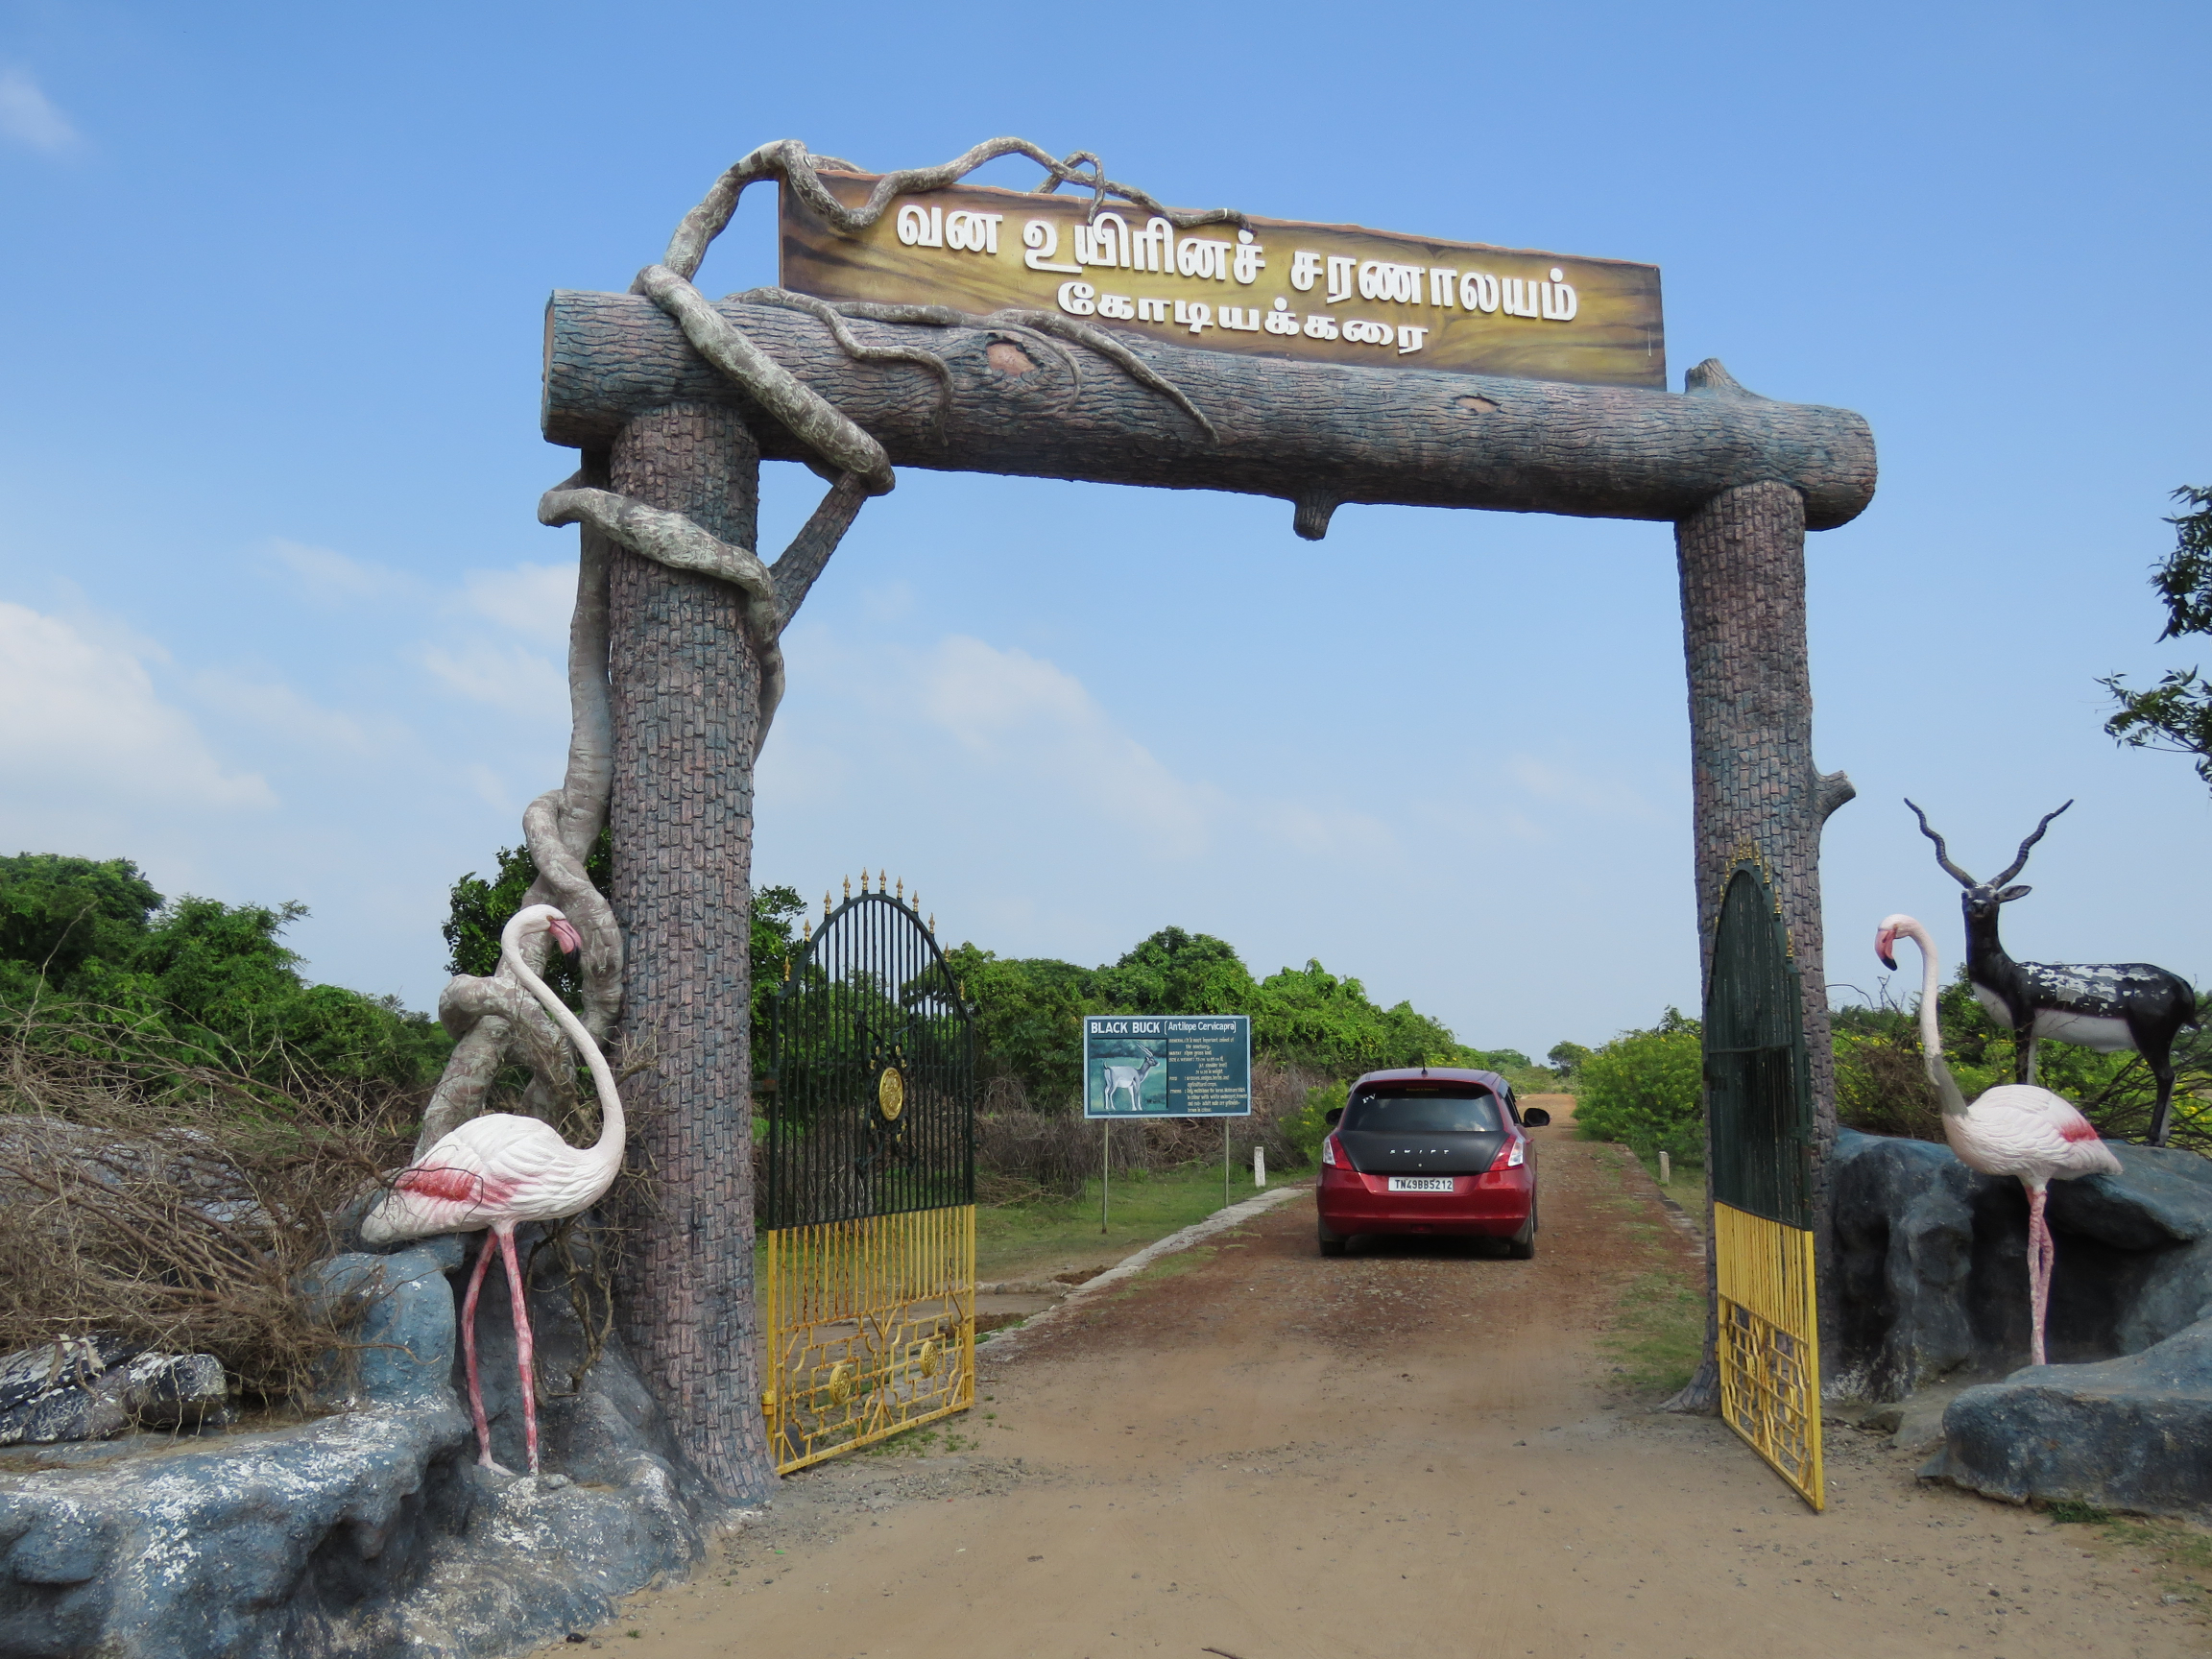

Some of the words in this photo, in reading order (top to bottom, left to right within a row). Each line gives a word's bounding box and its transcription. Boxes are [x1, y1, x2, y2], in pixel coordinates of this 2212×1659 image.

[897, 204, 1003, 254] வன
[1022, 211, 1266, 285] உயிரினச்
[1290, 250, 1578, 323] சரணாலயம்
[1057, 281, 1430, 355] கோடியக்கரை
[1091, 1022, 1128, 1034] BLACK
[1132, 1022, 1161, 1034] BUCK
[1394, 1179, 1453, 1190] TN49BB5212
